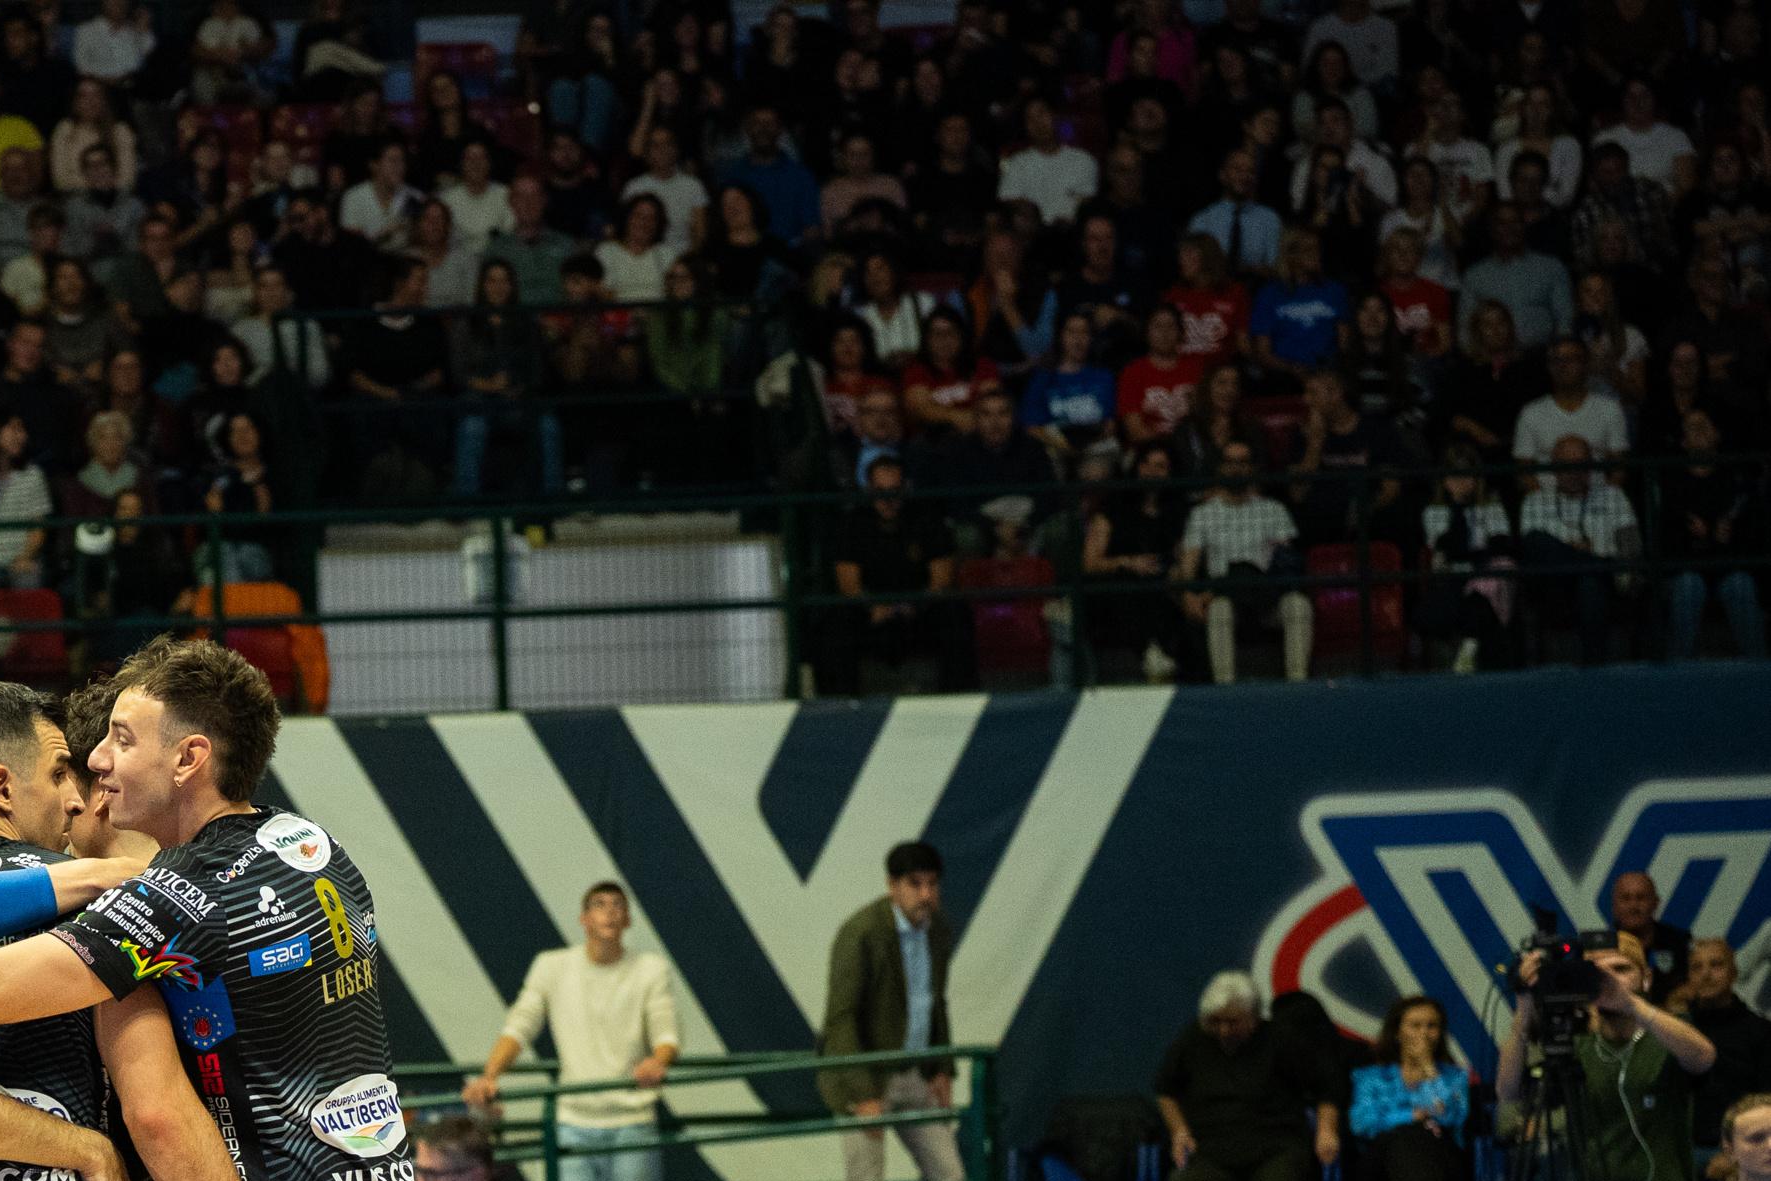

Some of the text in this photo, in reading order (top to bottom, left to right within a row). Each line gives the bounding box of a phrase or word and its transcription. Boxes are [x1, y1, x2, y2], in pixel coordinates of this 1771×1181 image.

[113, 899, 166, 943] Siderurgico
[121, 892, 154, 917] Centro
[255, 910, 298, 929] adrenalina
[313, 877, 353, 959] 8
[104, 908, 154, 949] Industriale
[261, 942, 304, 967] saci
[321, 959, 373, 1005] LOSER
[325, 1085, 388, 1111] GRUPPO ALIMENTA
